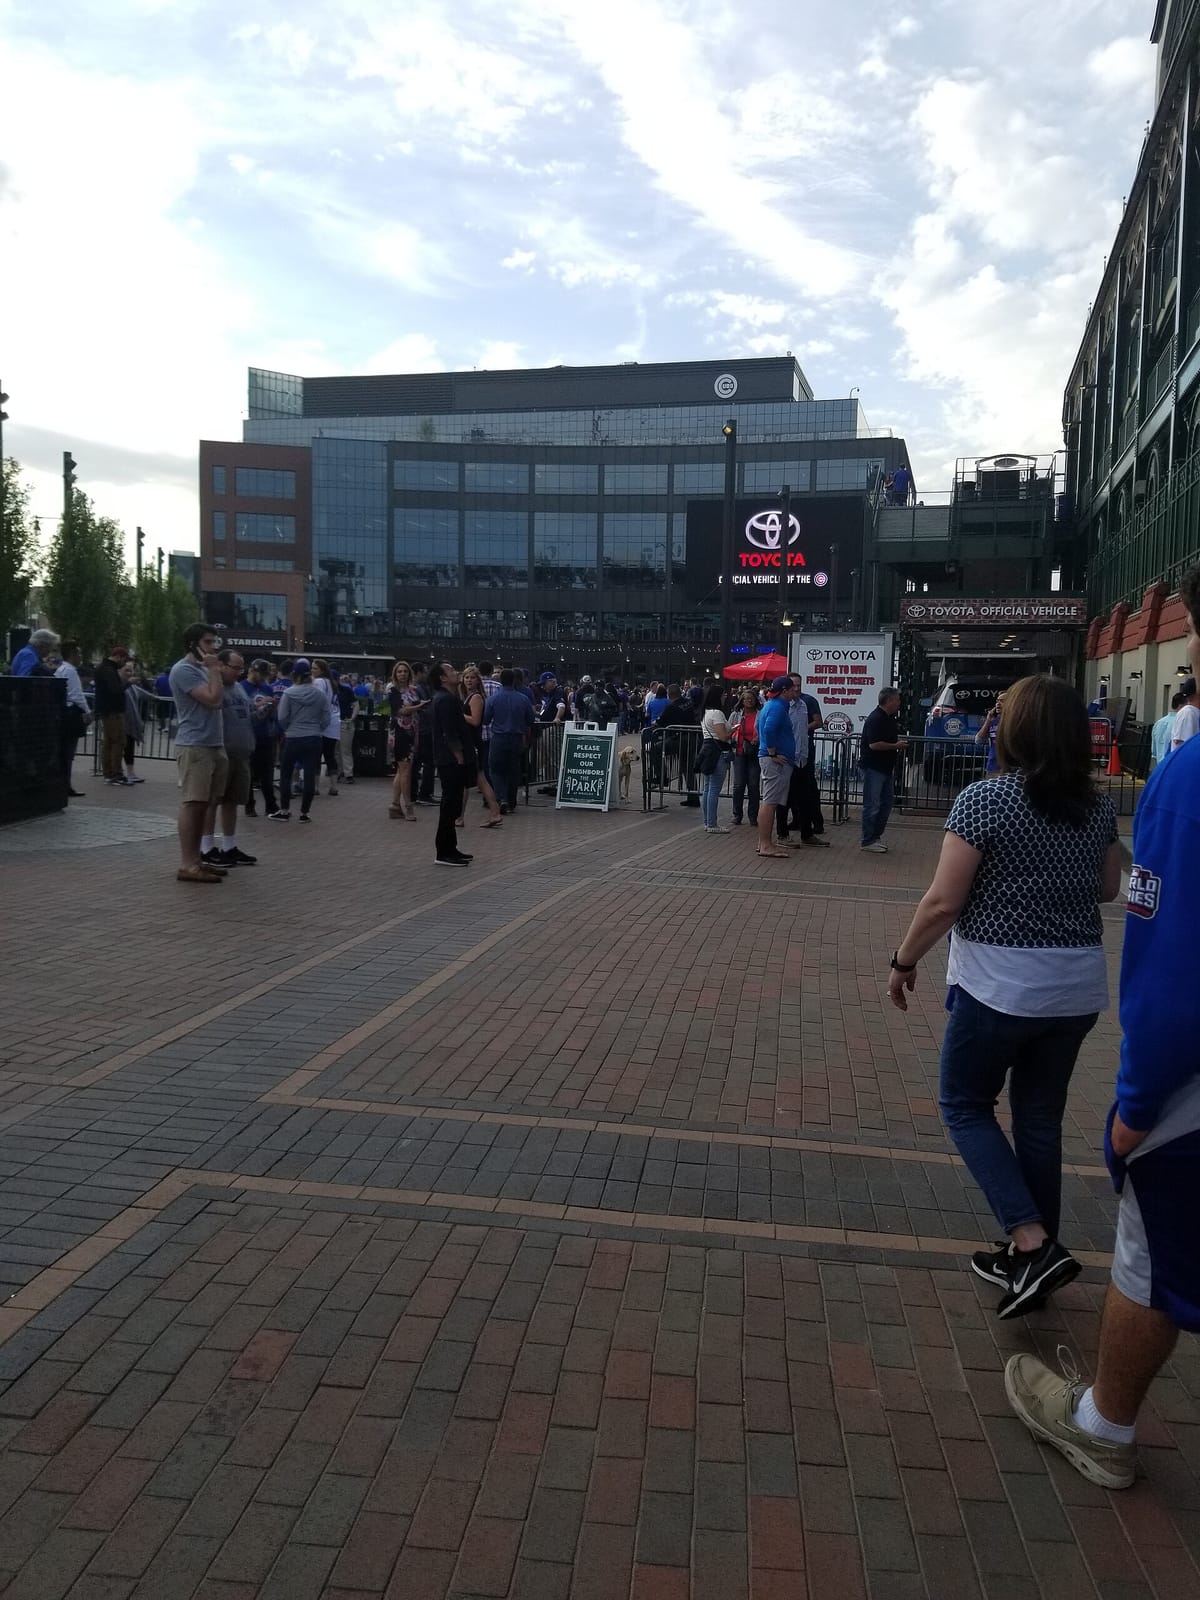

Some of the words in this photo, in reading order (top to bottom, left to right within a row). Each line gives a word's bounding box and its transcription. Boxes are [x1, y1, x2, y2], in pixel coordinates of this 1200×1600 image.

[739, 553, 806, 567] TOYOTA
[752, 575, 781, 584] VEHICL
[796, 575, 811, 584] THE
[928, 606, 975, 616] TOYOTA
[980, 606, 1029, 616] OFFICIAL
[1031, 606, 1078, 616] VEHICLE
[227, 638, 282, 647] STARBUCKS
[824, 650, 876, 661] TOYOTA
[814, 664, 838, 674] ENTER
[839, 664, 849, 674] TO
[850, 665, 867, 674] WIN
[847, 677, 875, 686] TICKETS
[829, 723, 846, 732] CUBS
[576, 744, 601, 752] PLEASE
[573, 752, 602, 760] RESPECT
[567, 768, 605, 776] NEIGHBORS
[571, 778, 598, 793] PARK
[1129, 877, 1157, 892] RLD
[1128, 890, 1156, 909] IES
